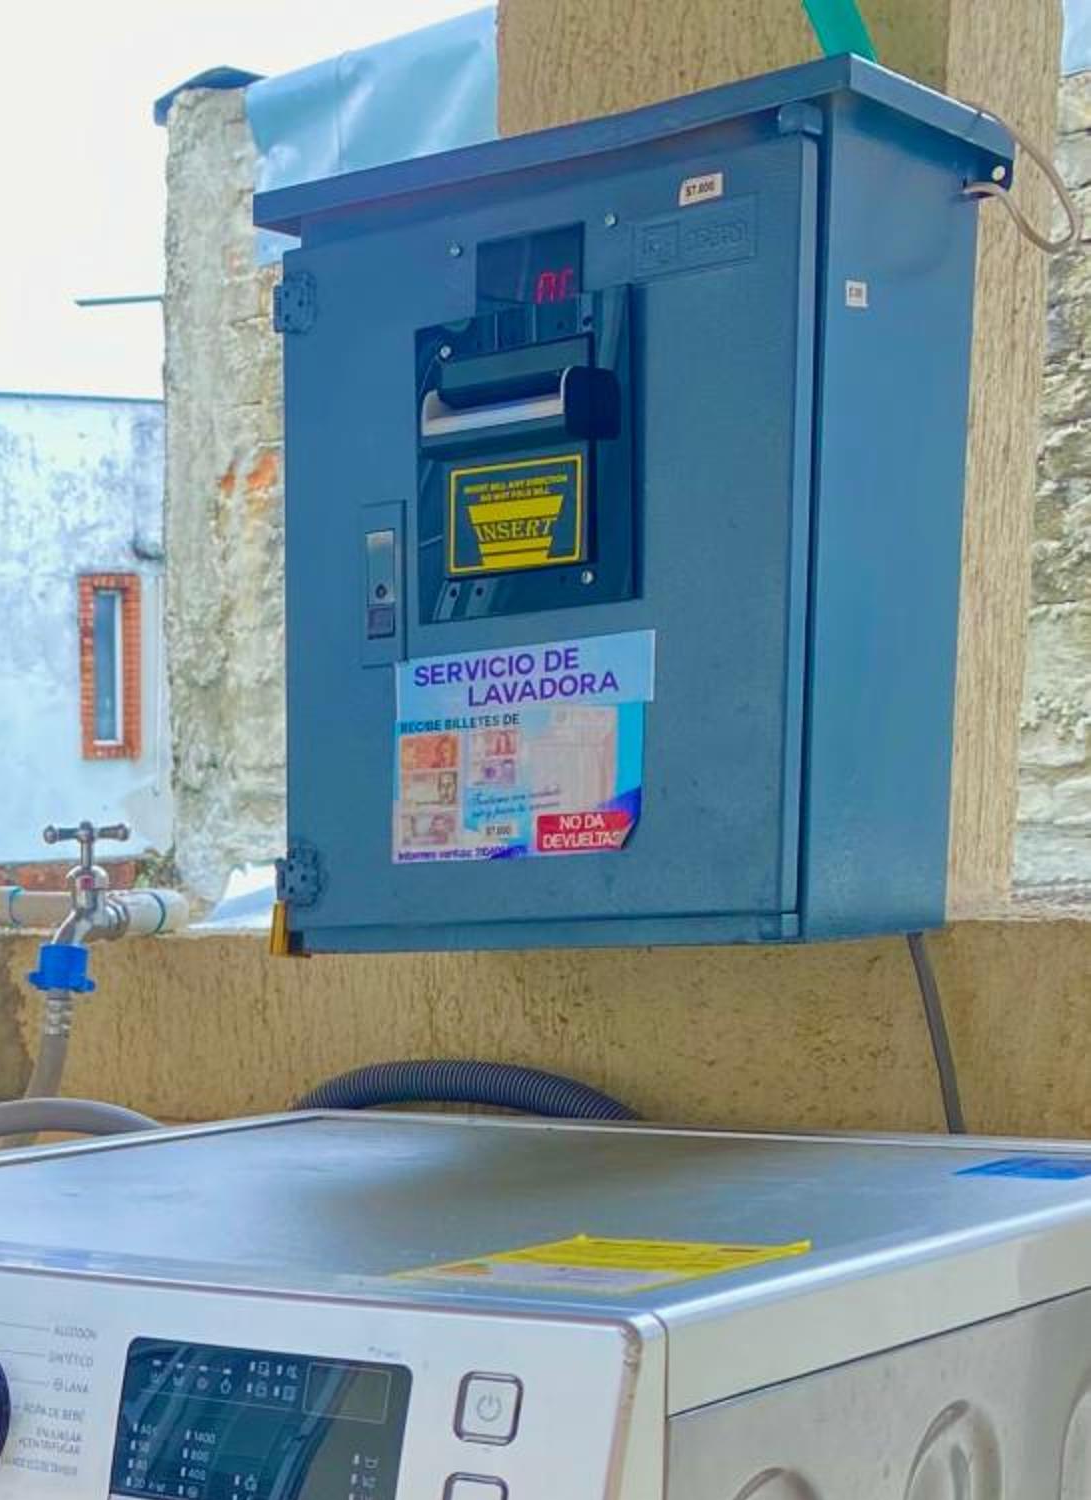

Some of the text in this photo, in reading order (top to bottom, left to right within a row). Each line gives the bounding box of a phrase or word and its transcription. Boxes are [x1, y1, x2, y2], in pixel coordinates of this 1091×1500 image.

[476, 518, 557, 541] INSERT
[414, 647, 579, 687] SERVICIO DE
[468, 671, 619, 707] LAVADORA
[401, 713, 520, 733] RECIBE BILLETES DE
[559, 813, 605, 831] NO DA
[543, 831, 623, 848] DEVUELTAS
